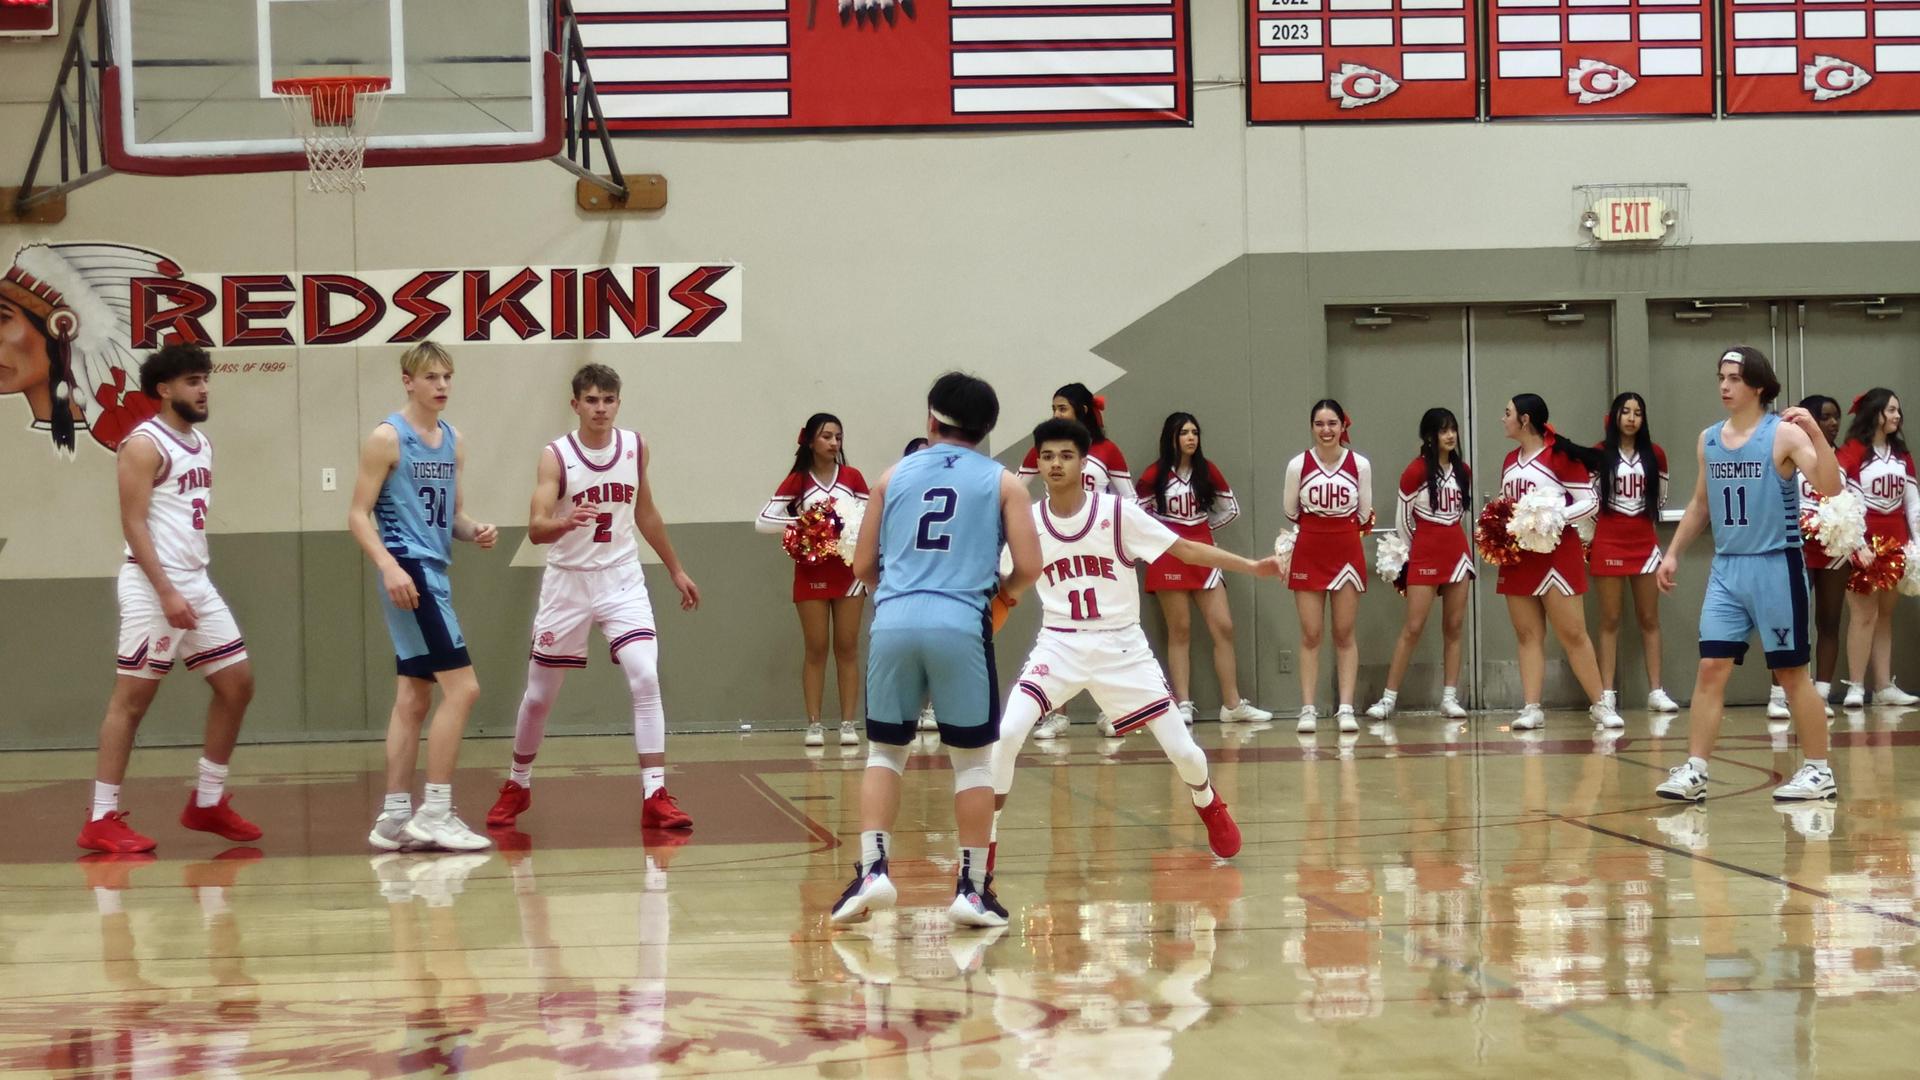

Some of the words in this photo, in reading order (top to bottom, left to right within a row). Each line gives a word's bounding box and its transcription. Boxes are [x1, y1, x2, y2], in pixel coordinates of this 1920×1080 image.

[1272, 24, 1309, 40] 2023
[1342, 73, 1381, 98] C
[1579, 69, 1618, 94] C
[1815, 65, 1854, 90] C
[1611, 202, 1652, 233] EXIT
[130, 266, 735, 349] REDSKINS
[209, 362, 240, 373] LASS
[242, 362, 258, 373] OF
[260, 361, 287, 373] 1999
[942, 455, 962, 469] Y
[1709, 461, 1763, 480] YOSEMITE
[572, 482, 635, 507] TRIBE
[1309, 483, 1350, 510] CUHS
[1437, 487, 1463, 513] UHS
[1871, 474, 1906, 500] CUHS
[1168, 491, 1200, 518] CUH
[1722, 485, 1749, 527] 11
[593, 512, 613, 543] 2
[915, 487, 959, 552] 2
[1043, 554, 1118, 588] TRIBE
[1068, 587, 1102, 621] 11
[1771, 627, 1791, 646] Y
